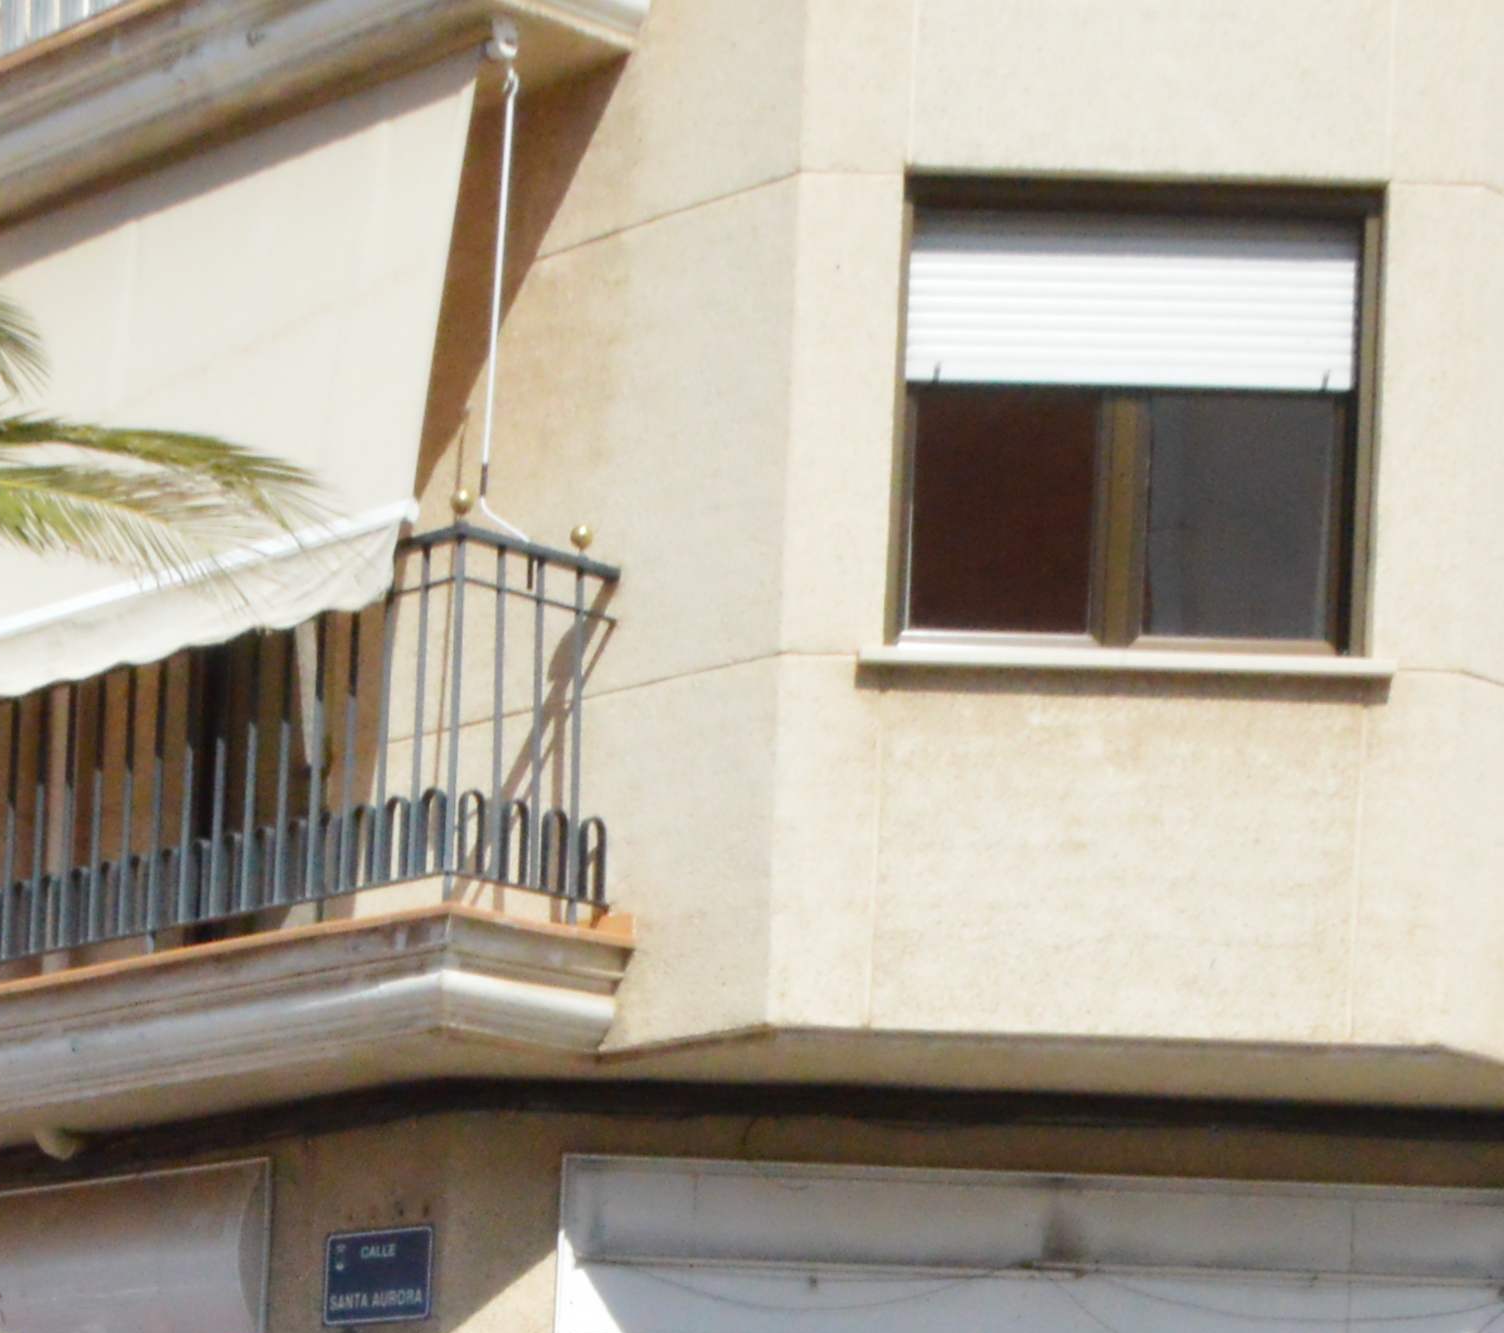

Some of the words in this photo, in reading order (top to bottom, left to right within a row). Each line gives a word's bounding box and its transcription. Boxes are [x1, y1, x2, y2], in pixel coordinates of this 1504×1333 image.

[360, 1243, 397, 1259] CALLE
[329, 1292, 369, 1312] SANTA
[372, 1288, 423, 1310] AURORA
